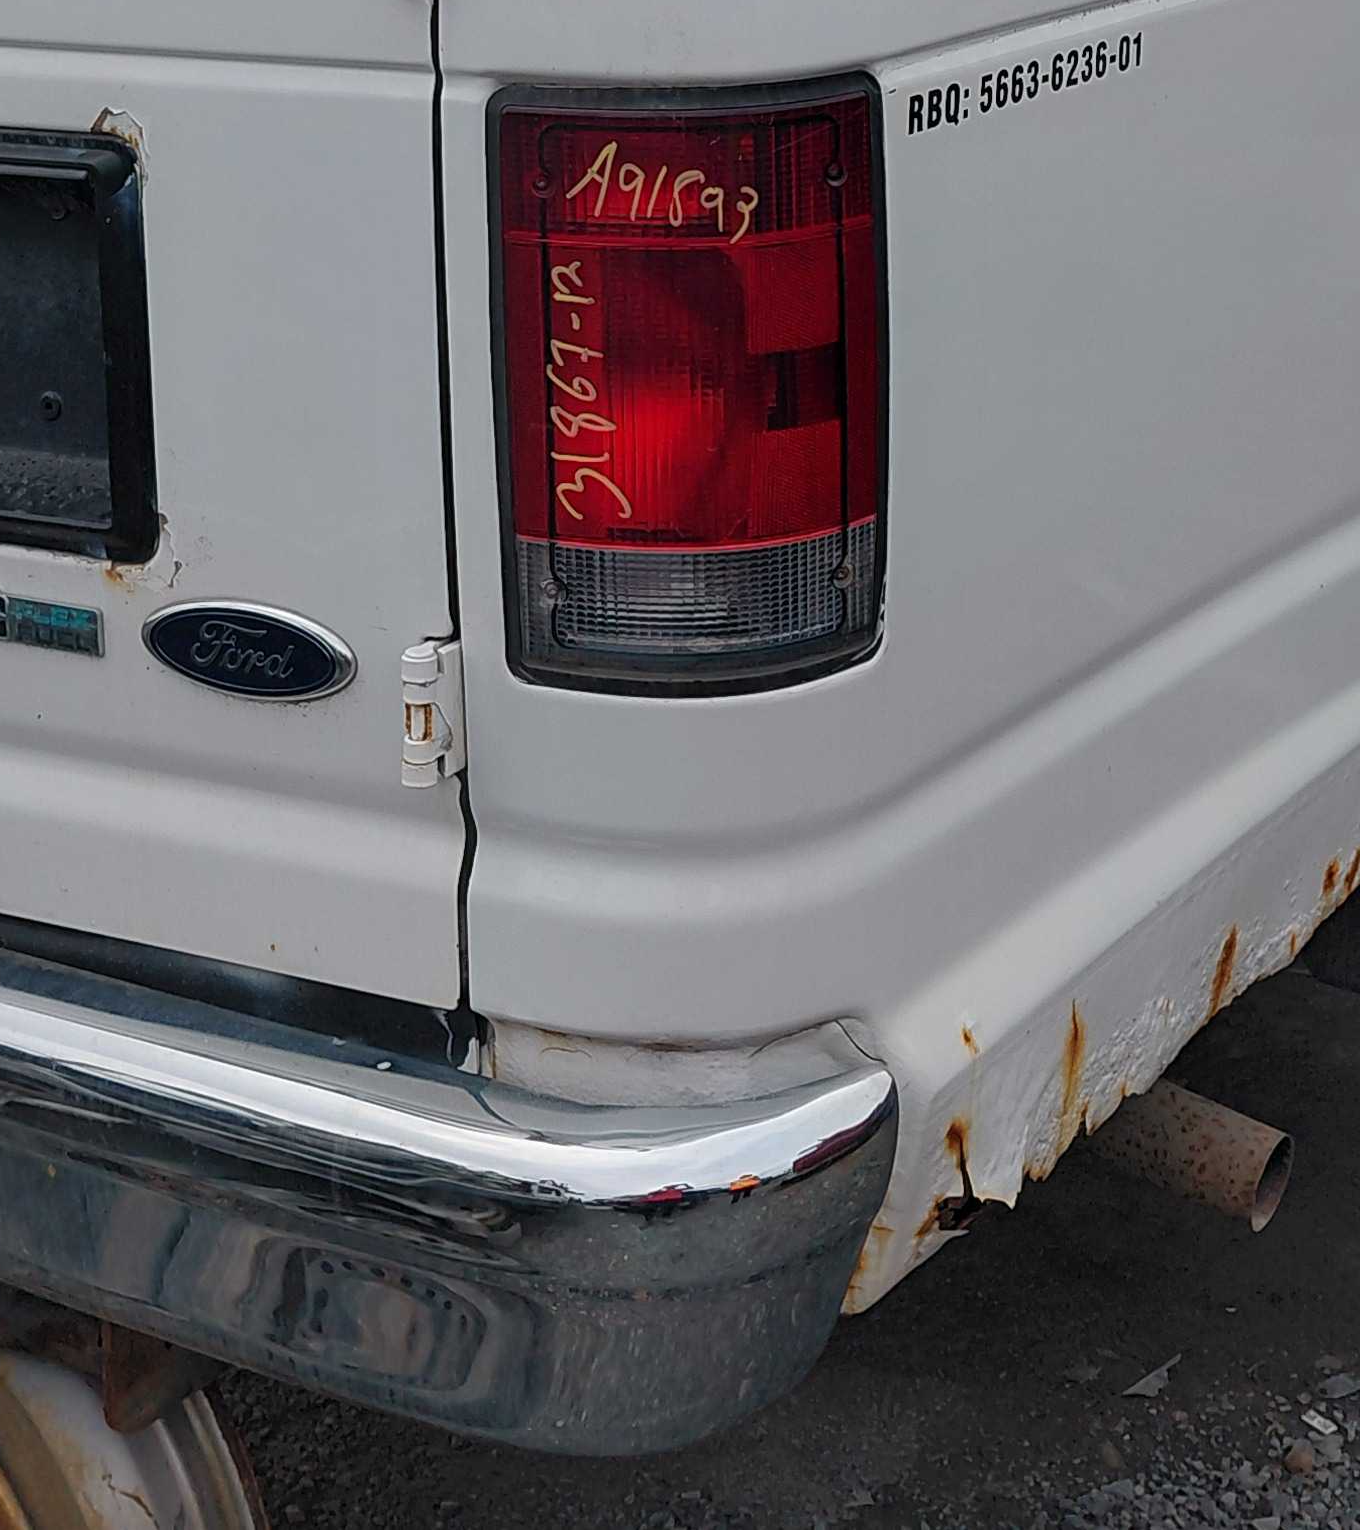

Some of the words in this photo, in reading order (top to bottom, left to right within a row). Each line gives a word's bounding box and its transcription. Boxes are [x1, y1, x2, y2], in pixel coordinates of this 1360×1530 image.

[907, 84, 970, 135] RBQ:
[979, 31, 1143, 115] 5663-6236-01
[566, 140, 758, 245] A91893
[191, 621, 295, 679] Ford
